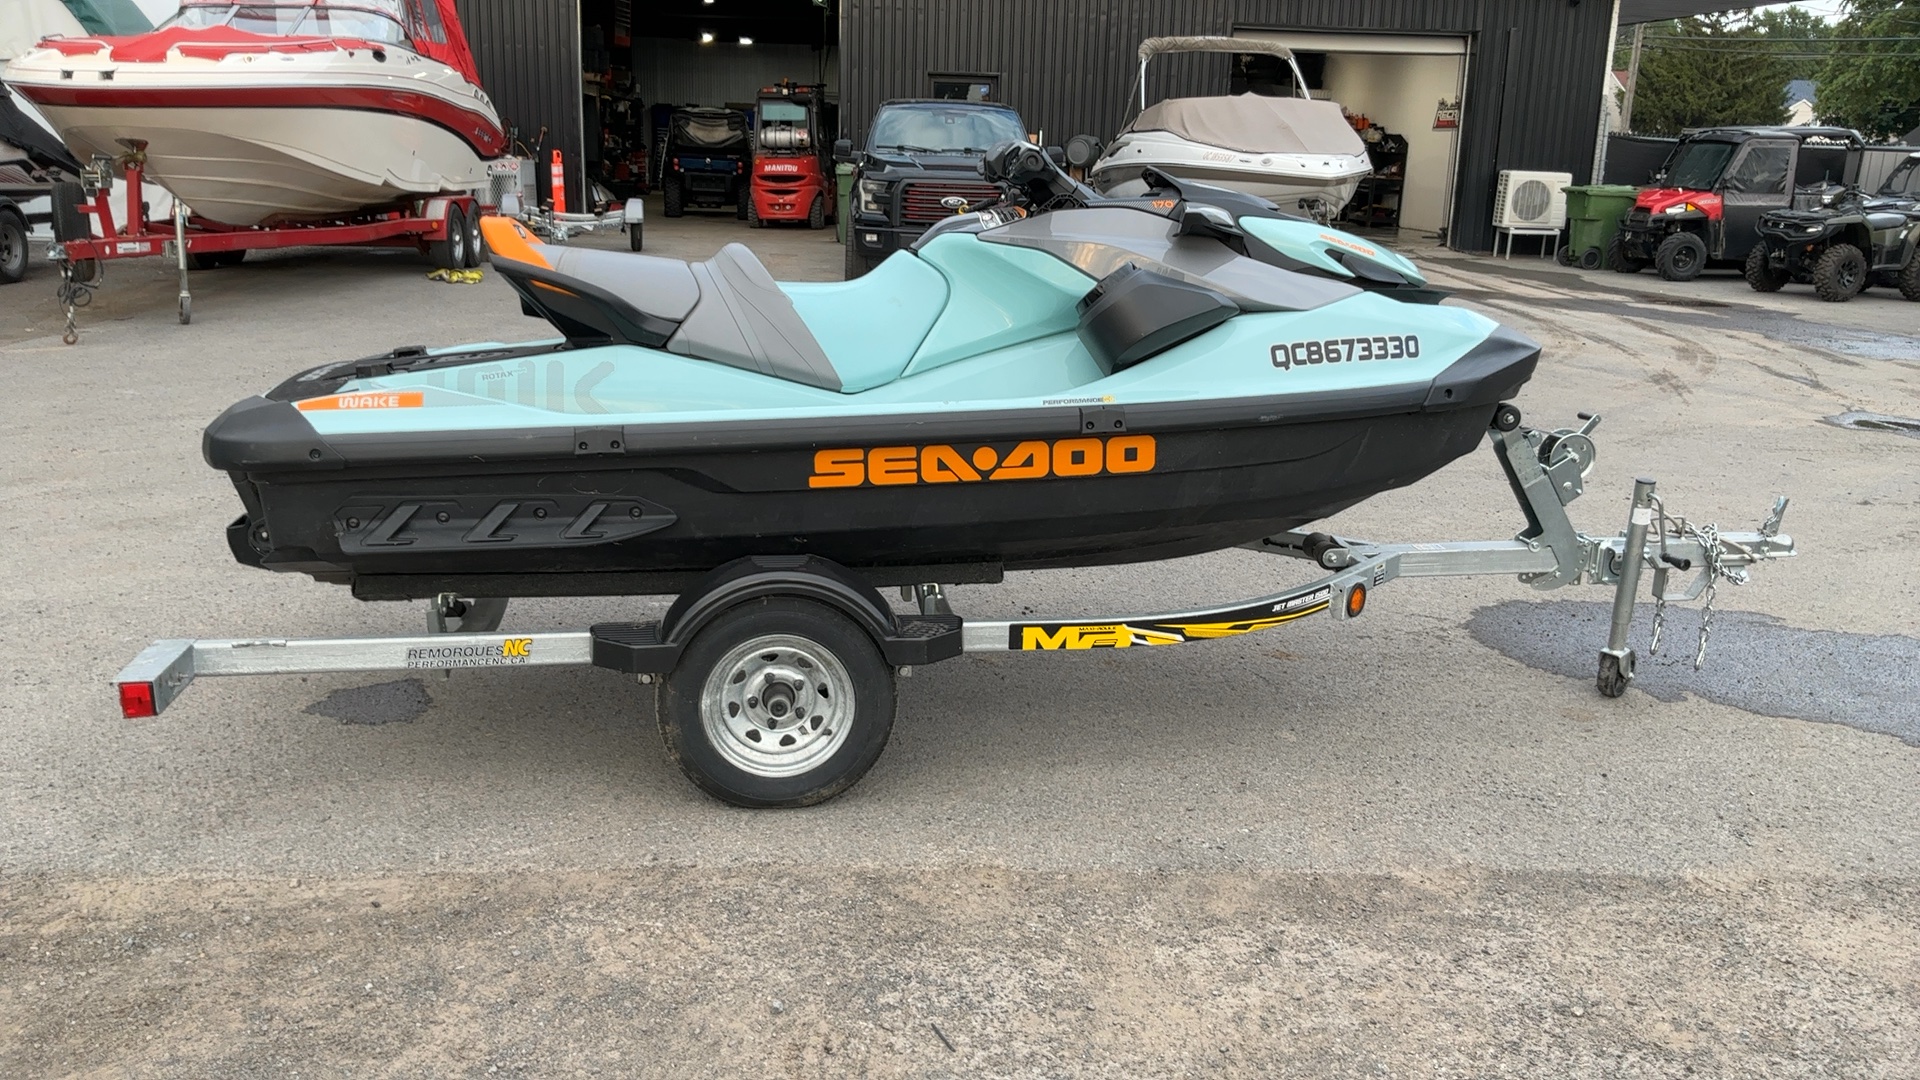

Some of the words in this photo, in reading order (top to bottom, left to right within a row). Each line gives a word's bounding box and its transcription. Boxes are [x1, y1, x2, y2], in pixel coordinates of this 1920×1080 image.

[764, 164, 798, 172] MANITOU
[1152, 200, 1174, 208] 170
[1270, 335, 1420, 371] QC8673330
[482, 370, 514, 381] ROTAX
[338, 395, 400, 408] WAKE
[1272, 603, 1286, 612] JET
[407, 656, 526, 668] PERFORMANCENC.CA
